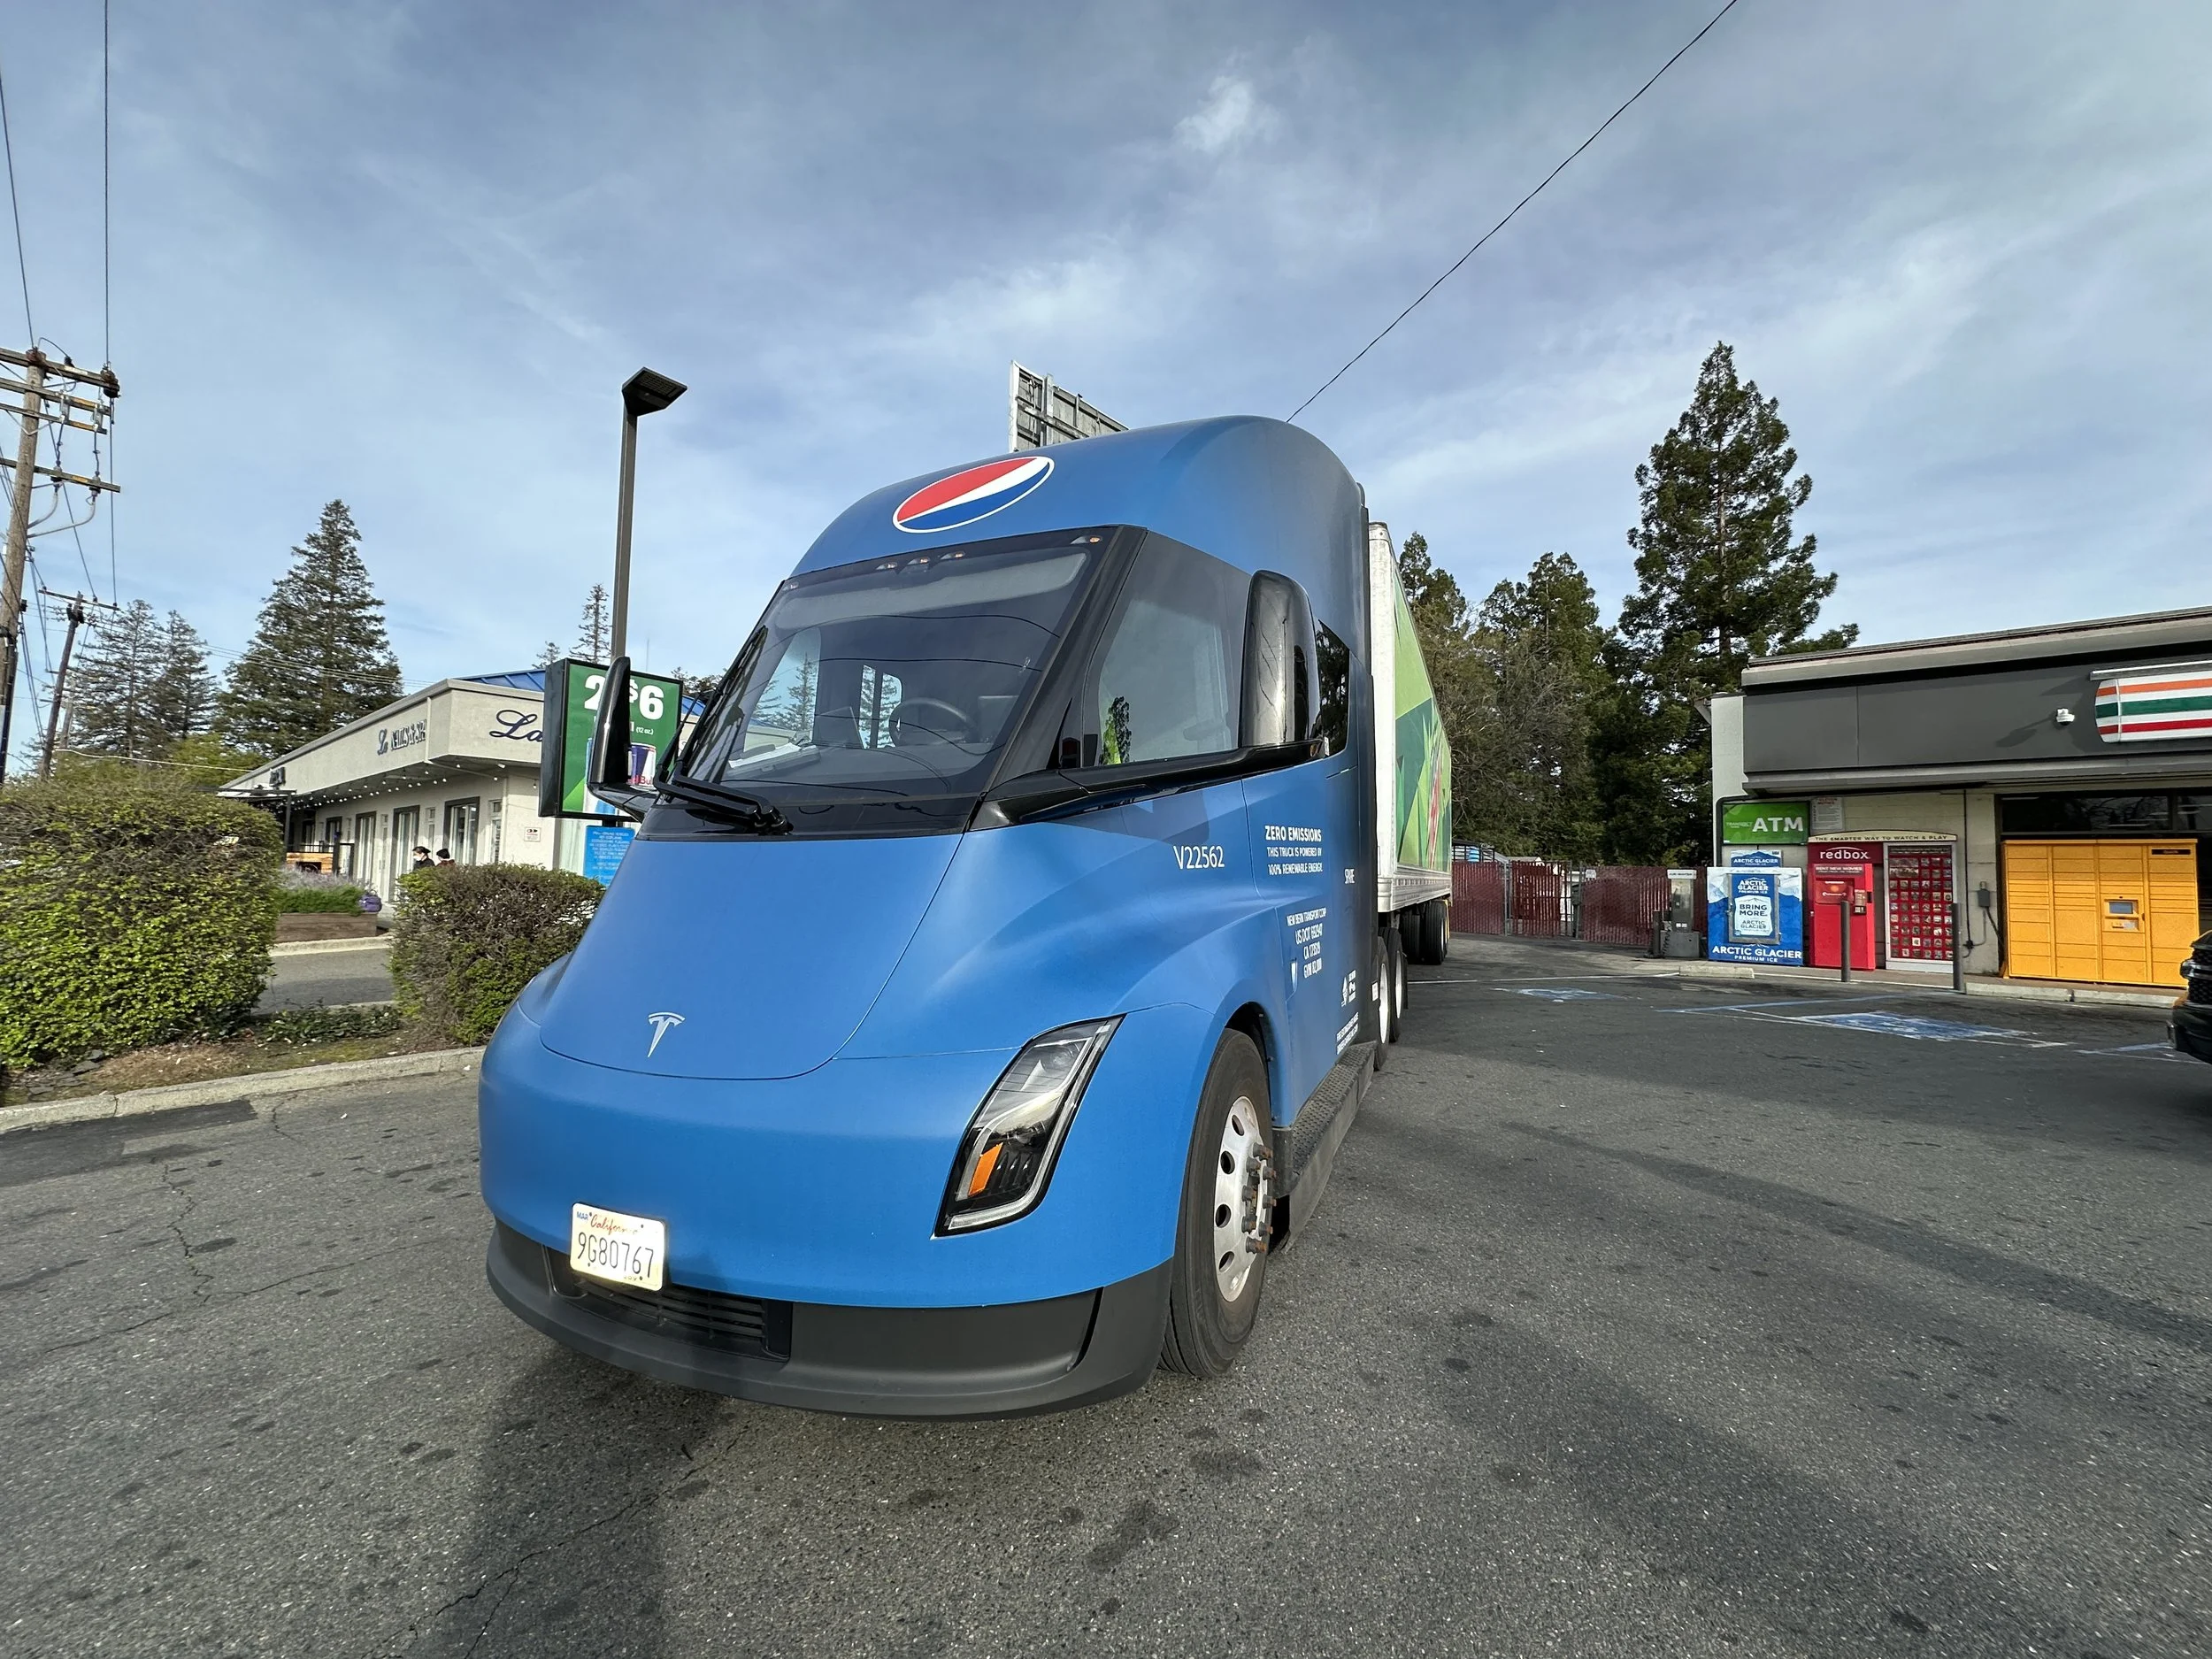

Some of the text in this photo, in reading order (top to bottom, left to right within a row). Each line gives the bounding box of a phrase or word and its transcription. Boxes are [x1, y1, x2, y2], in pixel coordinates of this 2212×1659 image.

[1752, 817, 1803, 832] ATM
[1264, 826, 1322, 841] ZERO EMISSIONS
[1173, 846, 1225, 869] V22562
[1266, 847, 1279, 857] THIS
[1279, 847, 1294, 857] TRUCK
[1294, 847, 1300, 857] IS
[1300, 847, 1317, 857] POWERED
[1820, 849, 1869, 859] redbox
[1268, 864, 1282, 875] 100%
[1282, 863, 1309, 874] RENEWABLE
[1712, 946, 1802, 959] ARCTIC GLACIER
[590, 1213, 638, 1235] Californ
[578, 1232, 654, 1279] 9G80767
